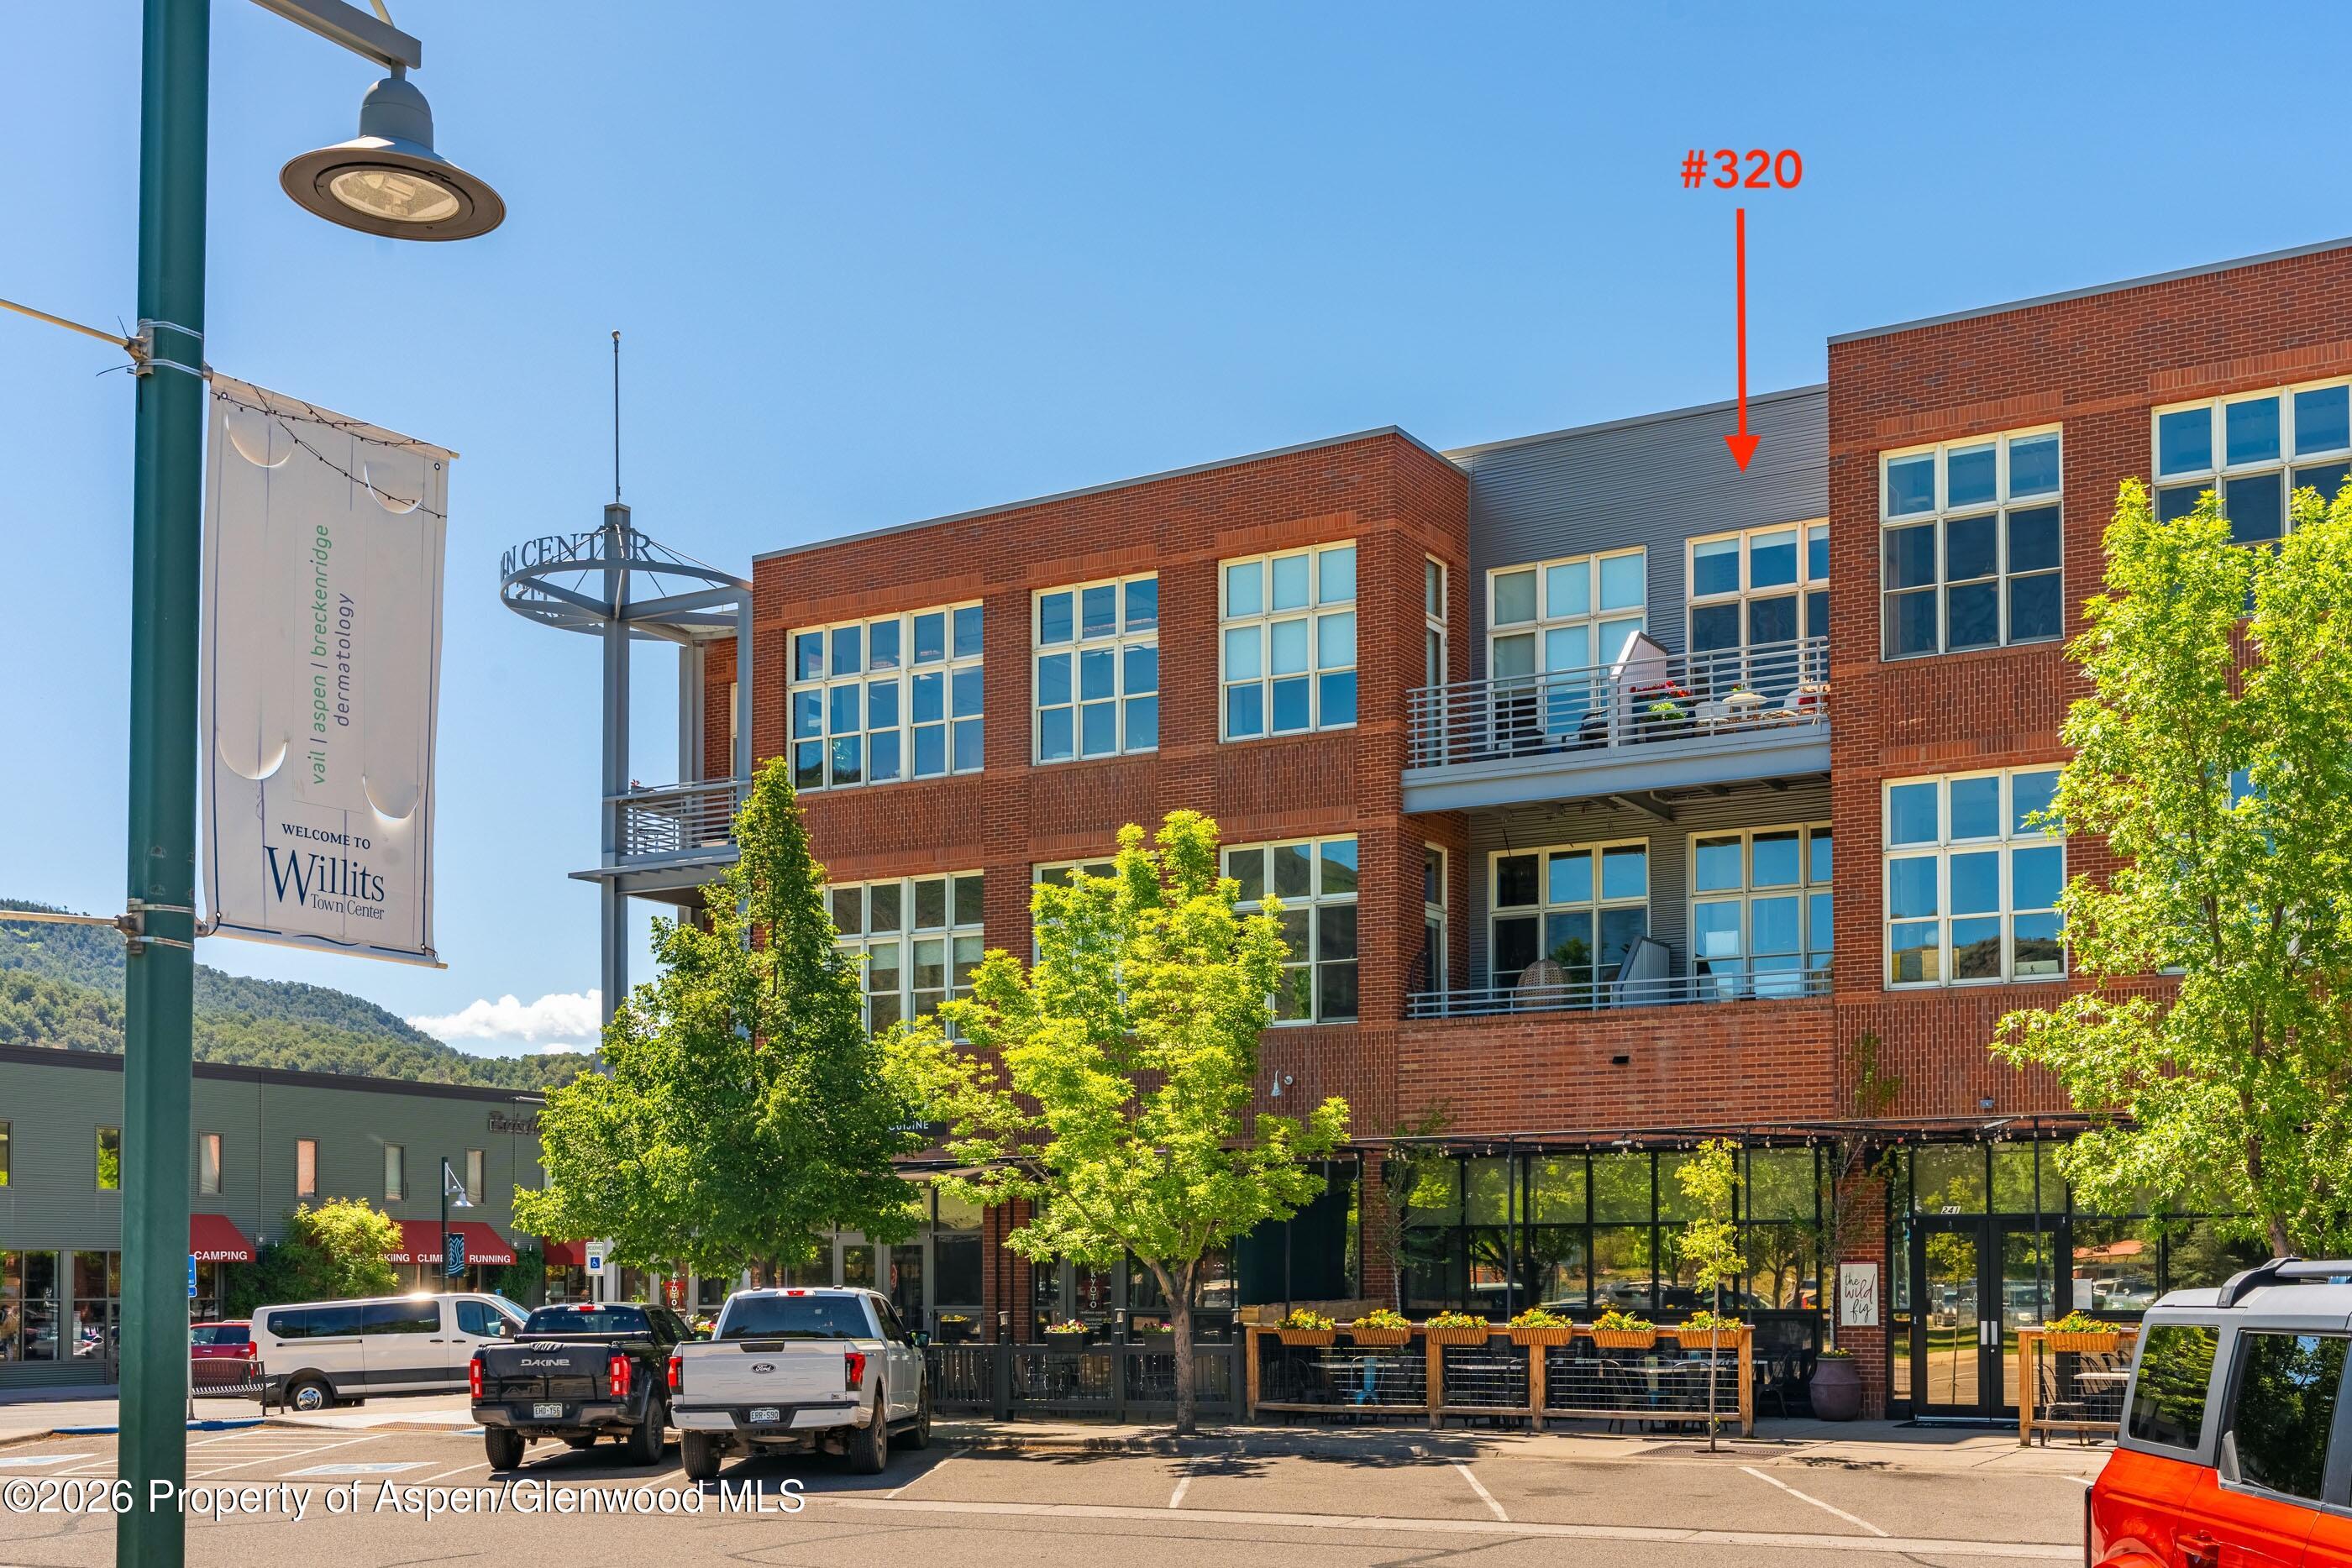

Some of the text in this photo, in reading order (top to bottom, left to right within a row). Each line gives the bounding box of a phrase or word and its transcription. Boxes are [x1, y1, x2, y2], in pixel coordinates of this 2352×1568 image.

[521, 527, 656, 568] CENTR
[310, 524, 332, 657] breckenridge
[333, 592, 354, 726] dermatology
[312, 674, 330, 733] aspen
[307, 751, 326, 784] vail
[281, 823, 370, 850] WELCOME TO
[263, 845, 385, 906] Willits
[311, 894, 385, 920] Town Center
[1942, 1206, 1959, 1214] 241
[193, 1251, 249, 1261] CAMPING
[469, 1255, 512, 1263] RUNNING
[1844, 1272, 1861, 1286] the
[1845, 1273, 1876, 1304] wild
[1850, 1298, 1872, 1324] fig
[519, 1358, 571, 1367] DAKINE
